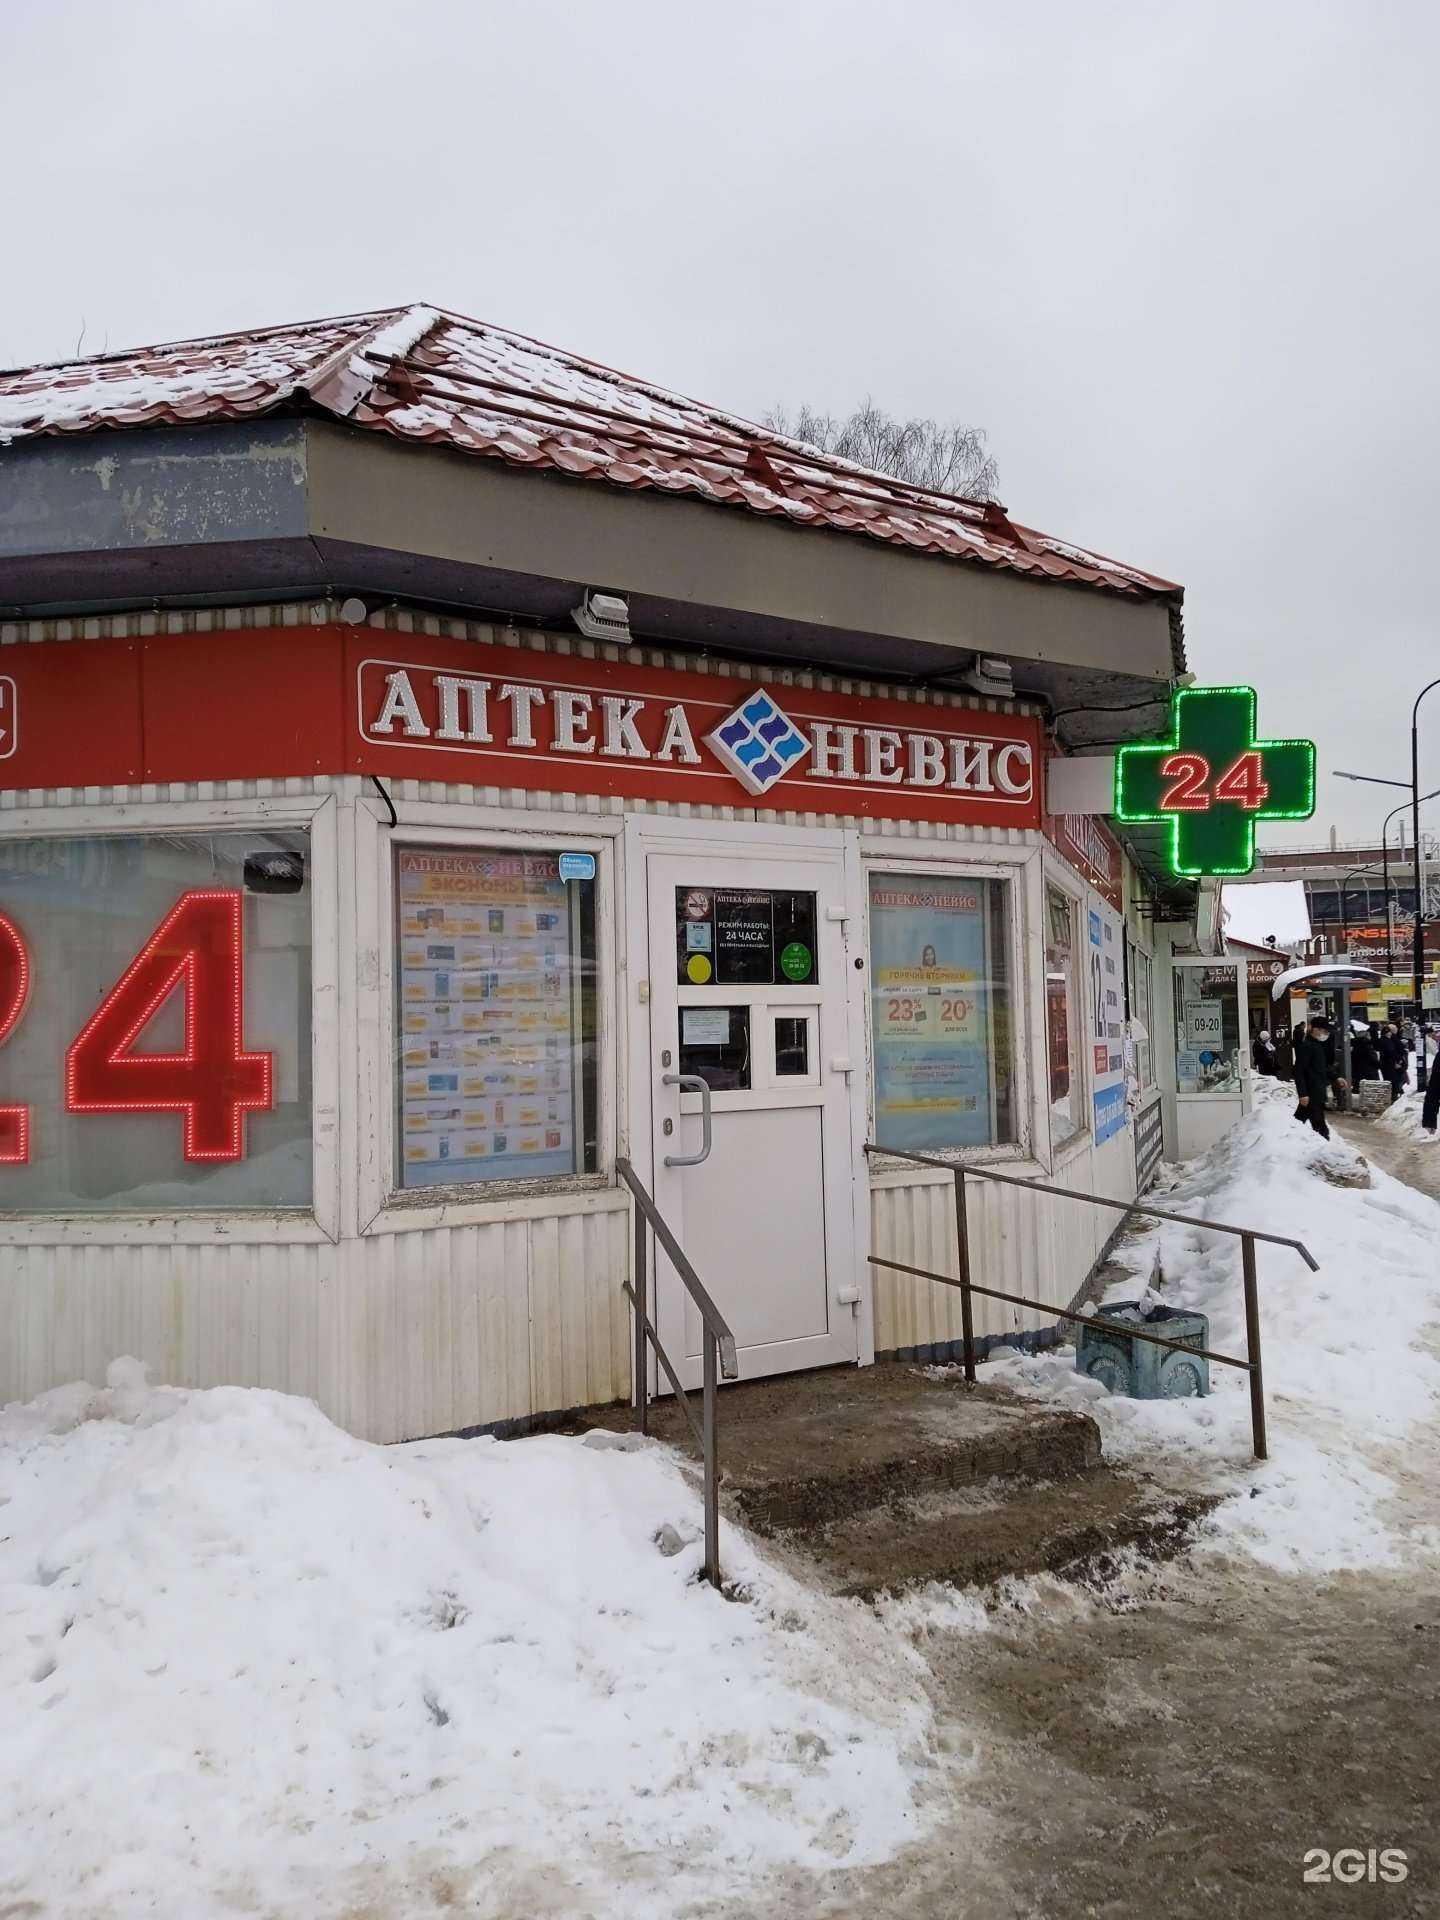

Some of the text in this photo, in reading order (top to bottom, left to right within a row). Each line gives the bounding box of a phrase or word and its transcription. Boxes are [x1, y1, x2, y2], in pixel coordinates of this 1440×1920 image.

[370, 669, 1032, 795] АПТЕКА НЕВИС
[1160, 752, 1269, 810] 24
[407, 857, 476, 873] АПТЕКА
[717, 895, 741, 903] АПТЕКА
[873, 893, 919, 905] АПТЕКА
[718, 921, 742, 929] РЕЖИМ
[726, 931, 764, 941] 24 ЧАСА
[0, 889, 274, 1163] 4
[1194, 1018, 1219, 1032] 09-20
